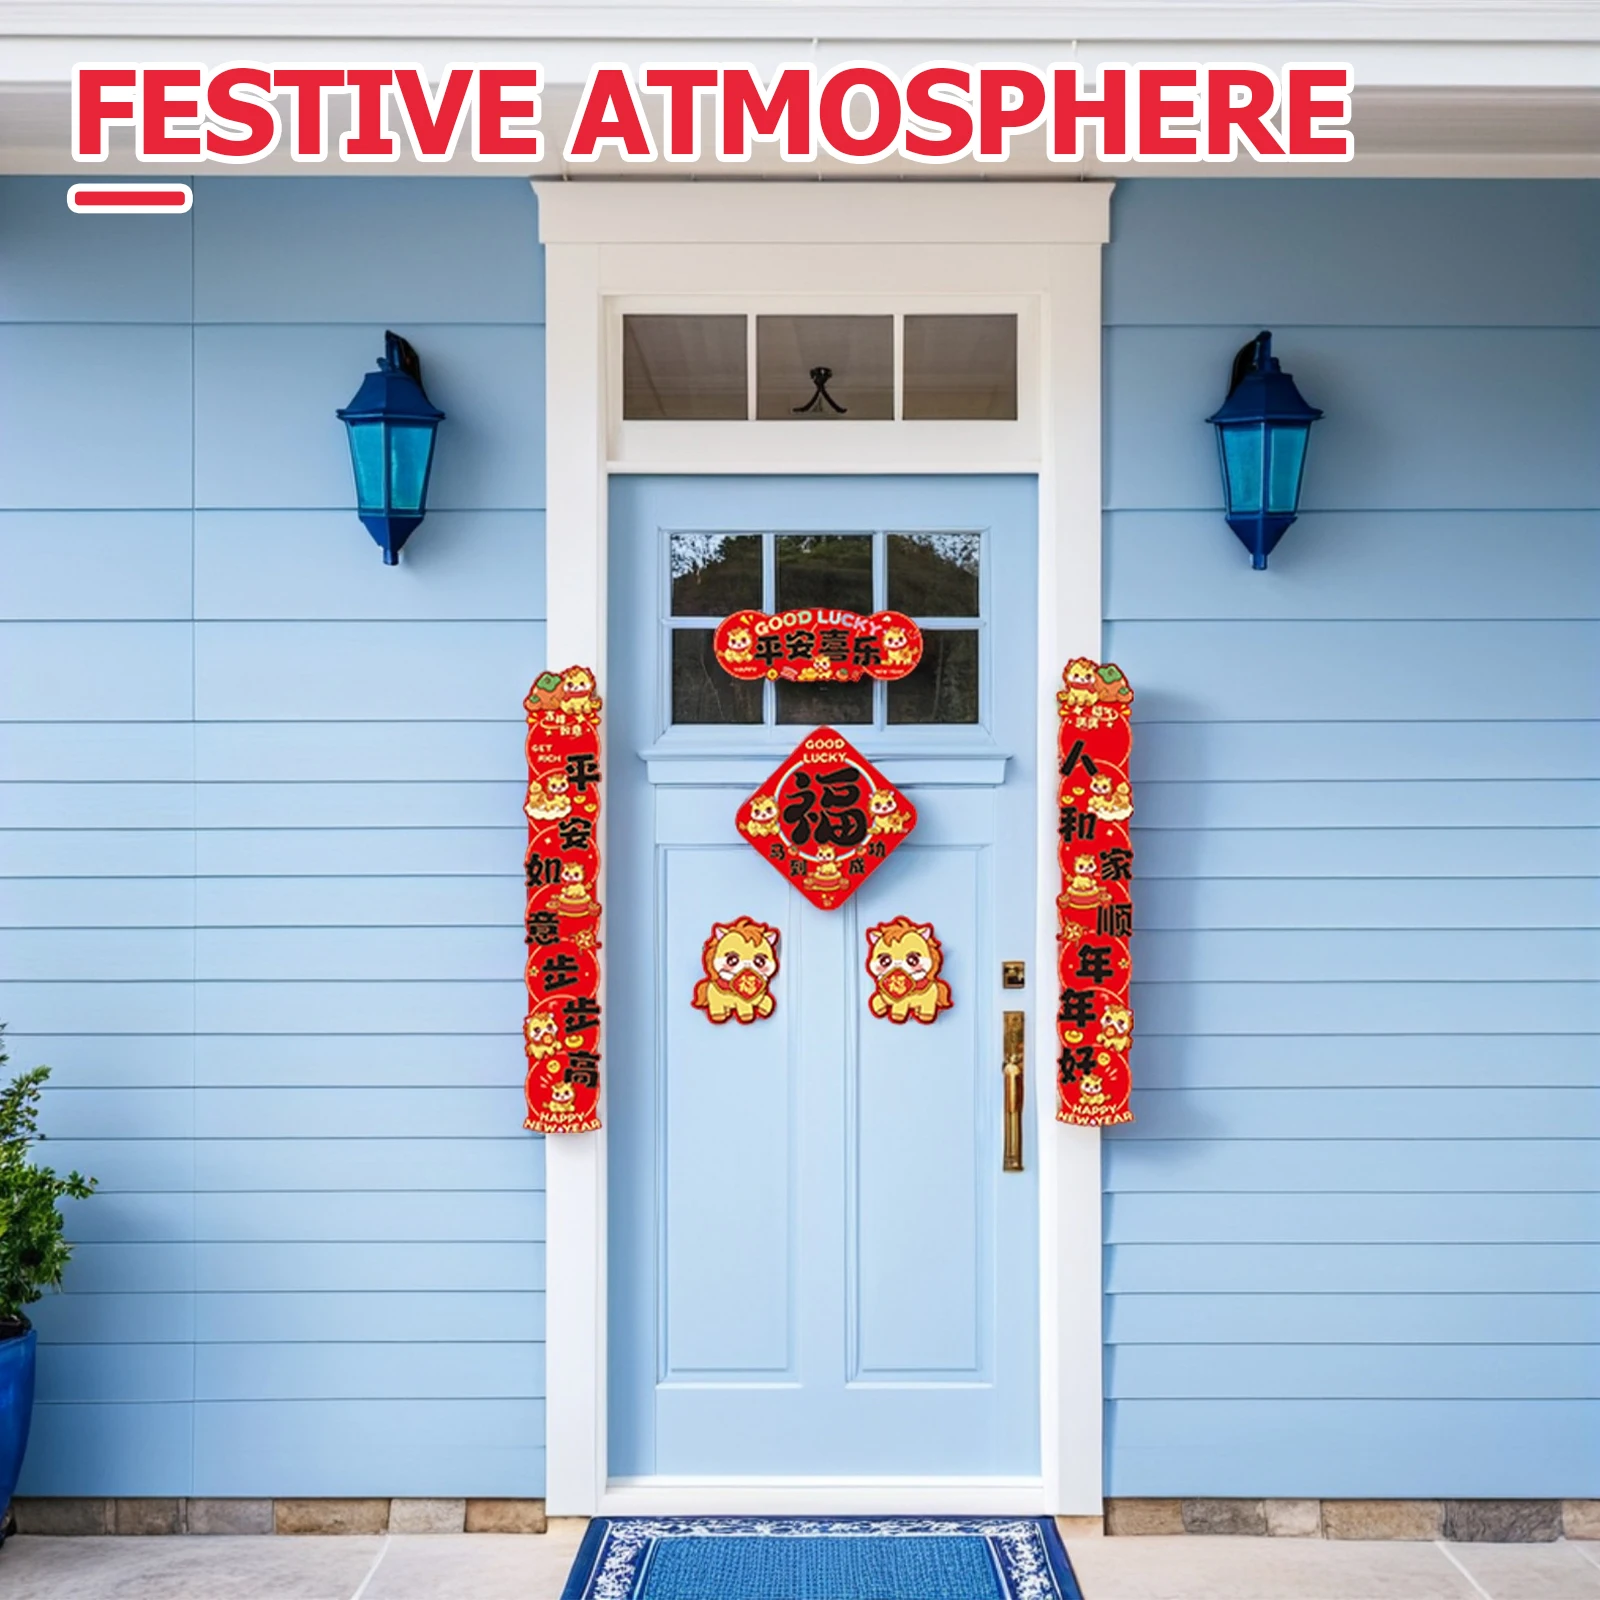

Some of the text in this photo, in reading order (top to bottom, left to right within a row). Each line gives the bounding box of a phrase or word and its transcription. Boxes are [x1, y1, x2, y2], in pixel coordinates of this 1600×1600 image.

[755, 610, 882, 636] GOOD LUCKY
[754, 629, 882, 666] 平安喜乐
[805, 739, 845, 750] GOOD
[803, 752, 847, 764] LUCKY
[782, 767, 868, 847] 福
[1059, 739, 1134, 1083] 人和家顺年年好
[525, 753, 601, 1088] 平安如意步步高
[1072, 1104, 1117, 1115] HAPPY
[540, 1112, 585, 1123] HAPPY
[1057, 1111, 1133, 1126] NEW YEAR
[524, 1119, 600, 1133] NEW YEAR
